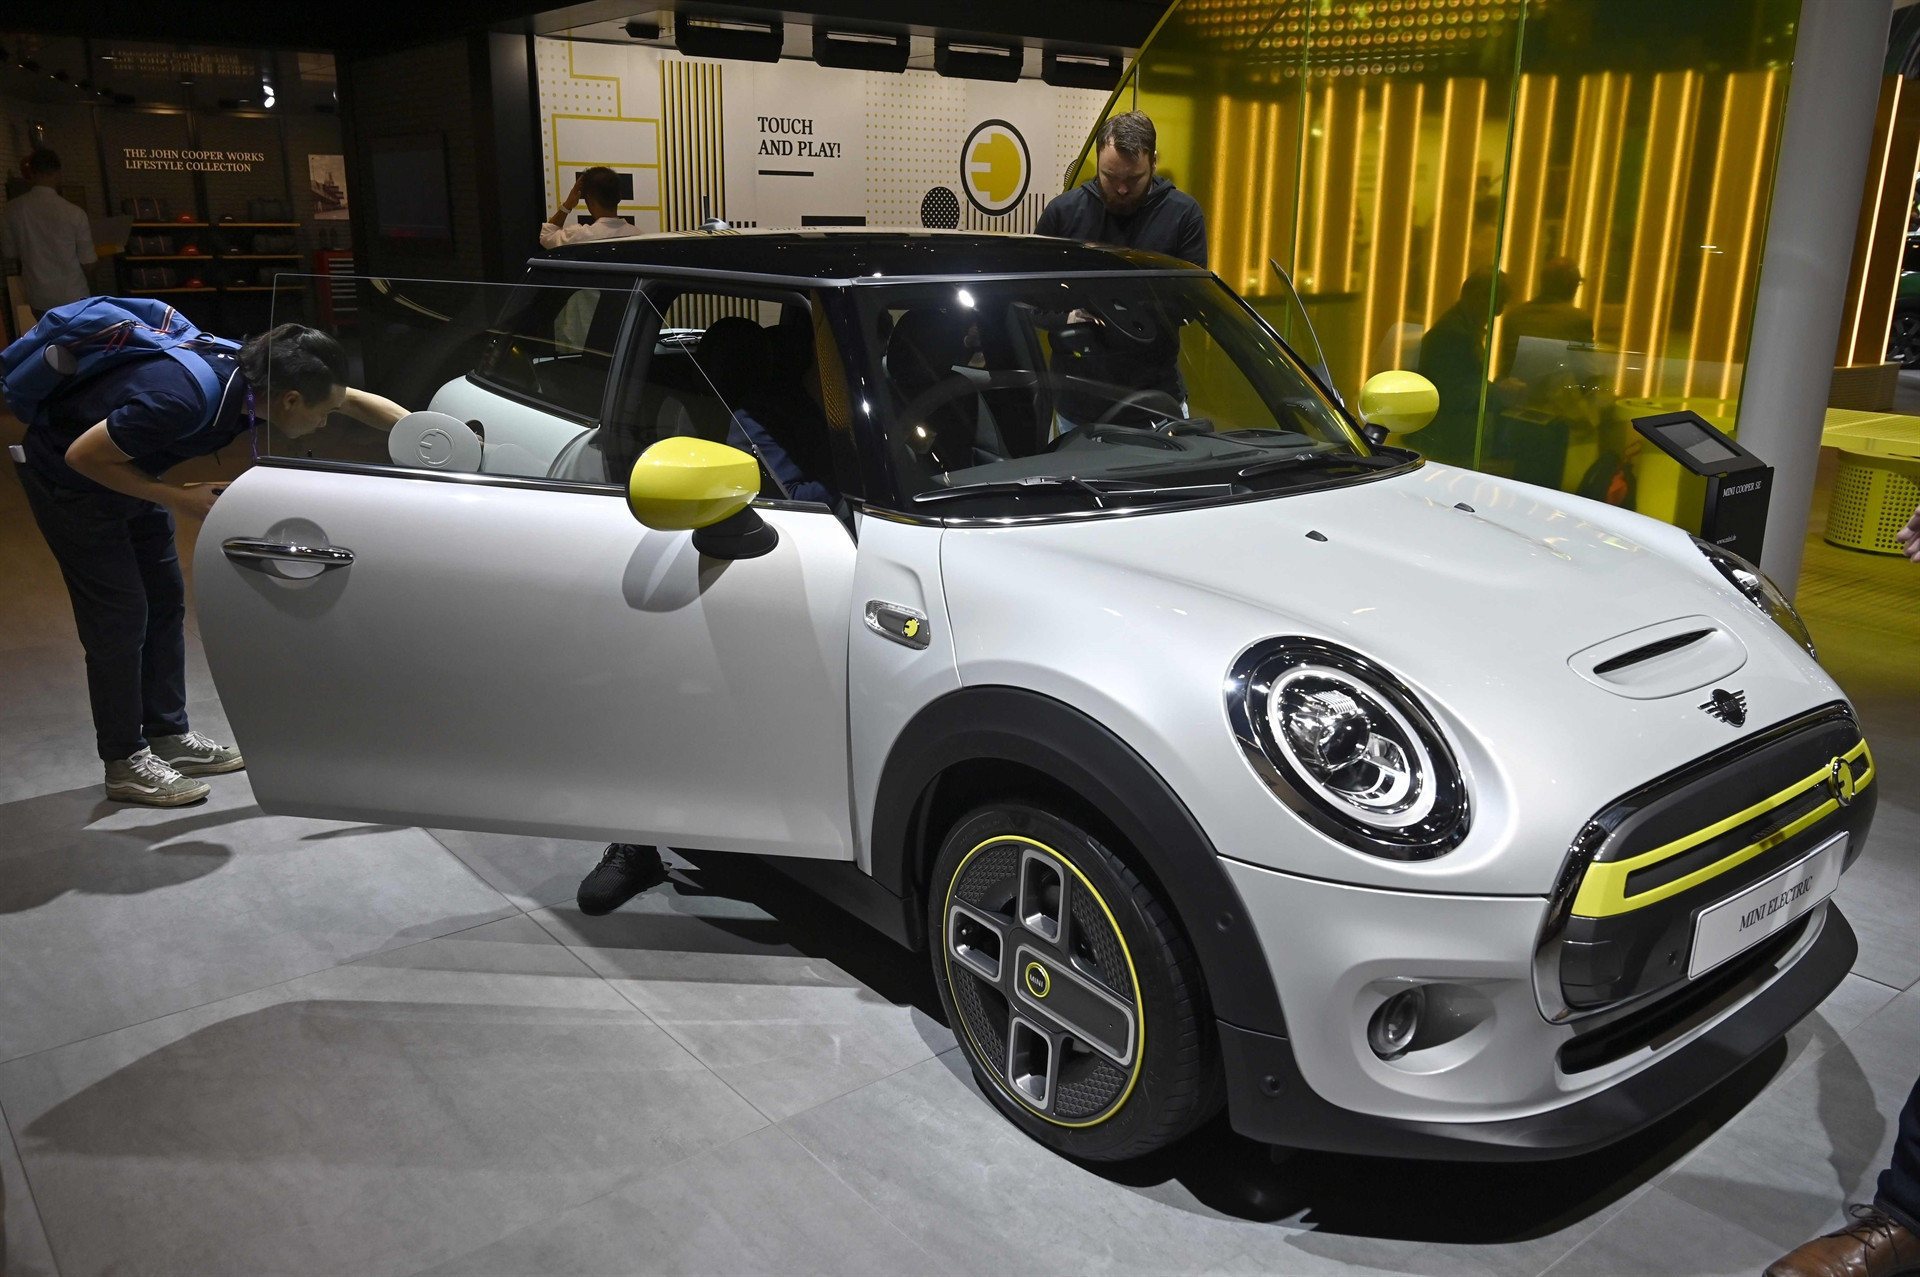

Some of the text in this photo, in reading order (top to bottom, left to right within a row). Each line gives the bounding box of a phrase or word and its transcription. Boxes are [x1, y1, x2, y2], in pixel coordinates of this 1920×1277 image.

[757, 116, 813, 135] TOUCH
[123, 148, 265, 162] THE JOHN COOPER WORKS
[758, 139, 841, 158] AND PLAY!
[125, 159, 251, 173] LIFESTYLE COLLECTION
[1722, 480, 1762, 498] MINI COOPER SE
[1738, 875, 1813, 932] MINI ELECTRIC
[1029, 973, 1044, 988] MINI
